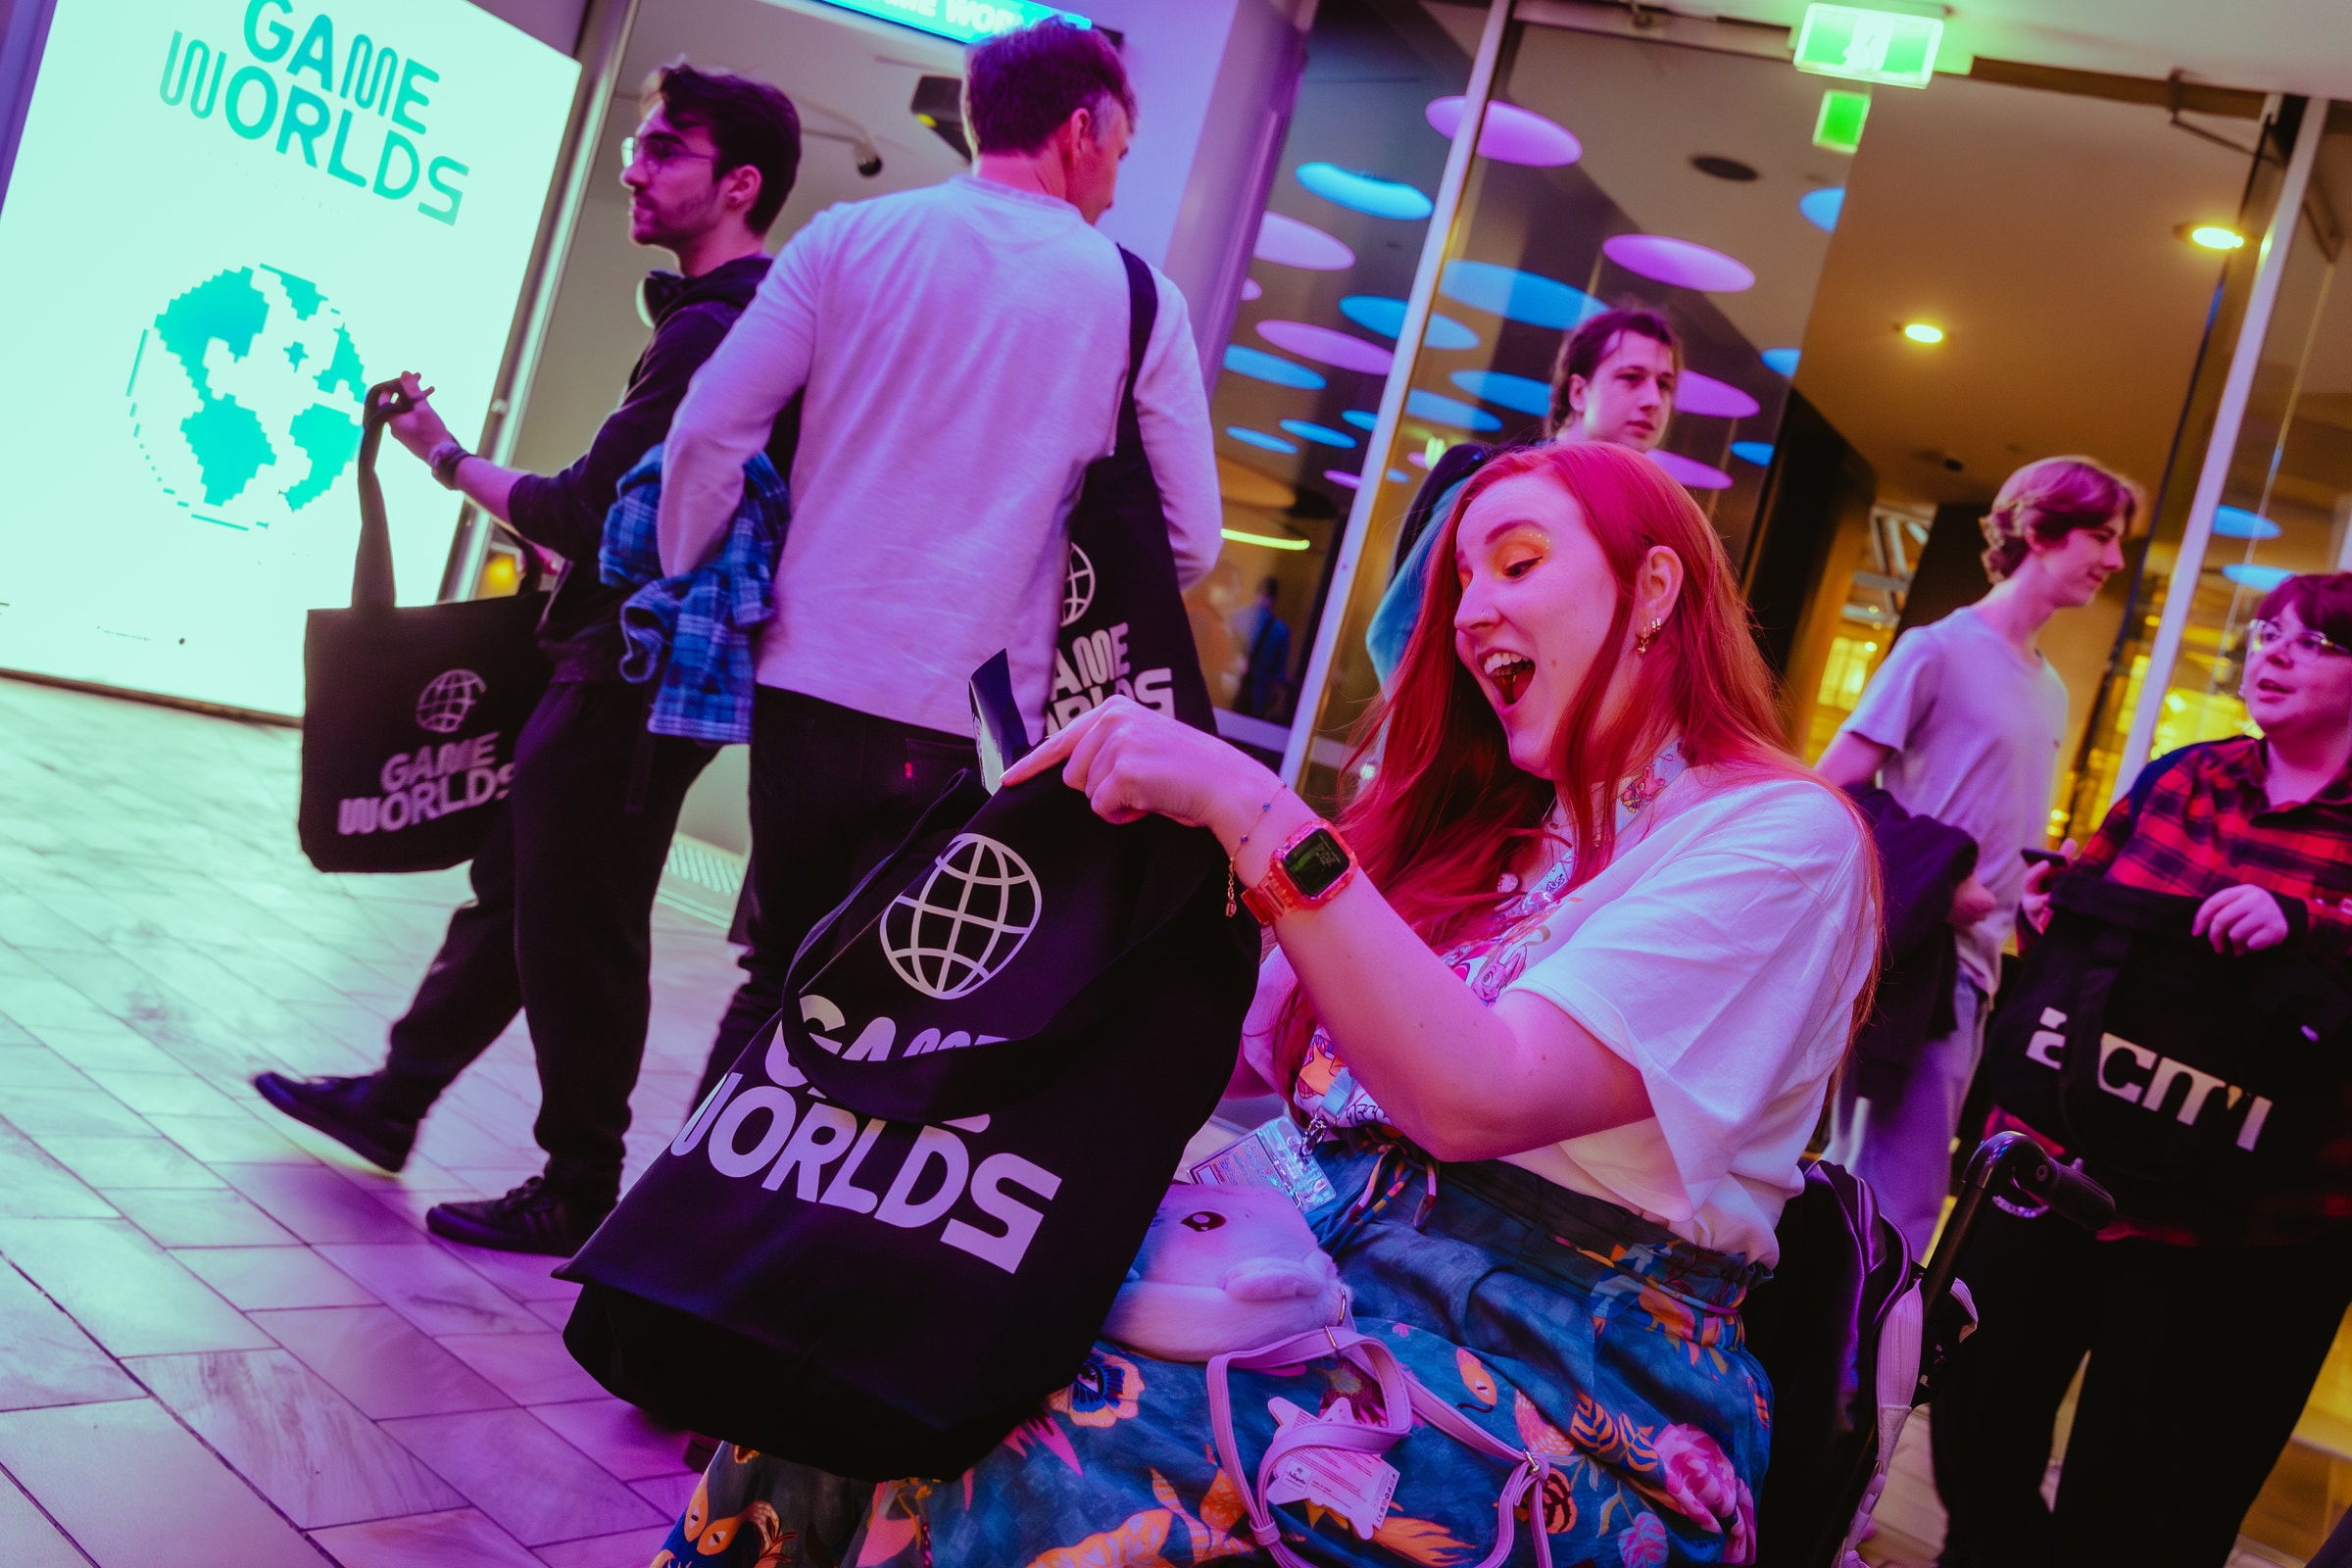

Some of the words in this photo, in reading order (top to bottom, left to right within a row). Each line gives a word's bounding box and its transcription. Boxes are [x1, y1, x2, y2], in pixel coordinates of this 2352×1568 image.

[946, 0, 1021, 34] WOR
[244, 0, 440, 135] GAME
[160, 29, 469, 226] WORLDS
[1049, 622, 1131, 703] AME
[380, 732, 501, 793] GAME
